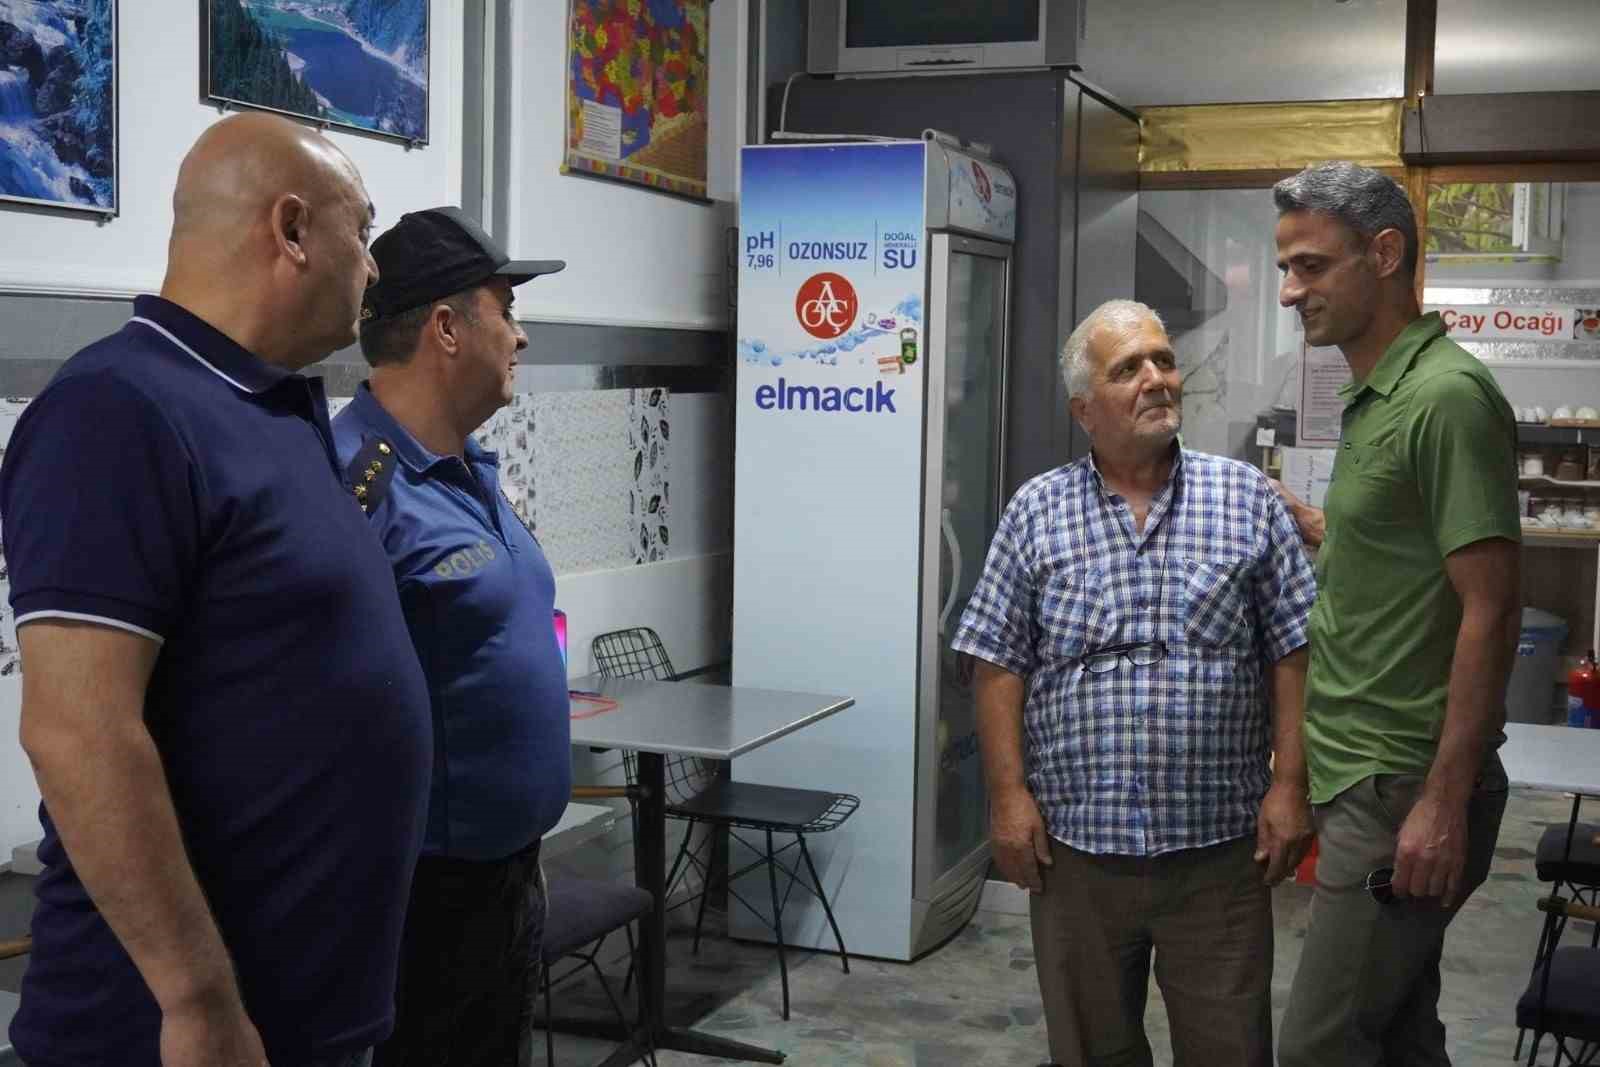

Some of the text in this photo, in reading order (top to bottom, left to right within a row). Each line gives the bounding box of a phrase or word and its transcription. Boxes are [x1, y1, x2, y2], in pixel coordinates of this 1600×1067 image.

[746, 231, 774, 253] pH
[789, 242, 868, 260] OZONSUZ
[747, 255, 774, 270] 7,96
[883, 249, 916, 269] SU
[1441, 310, 1562, 336] Çay Ocağı
[755, 377, 896, 413] elmacık
